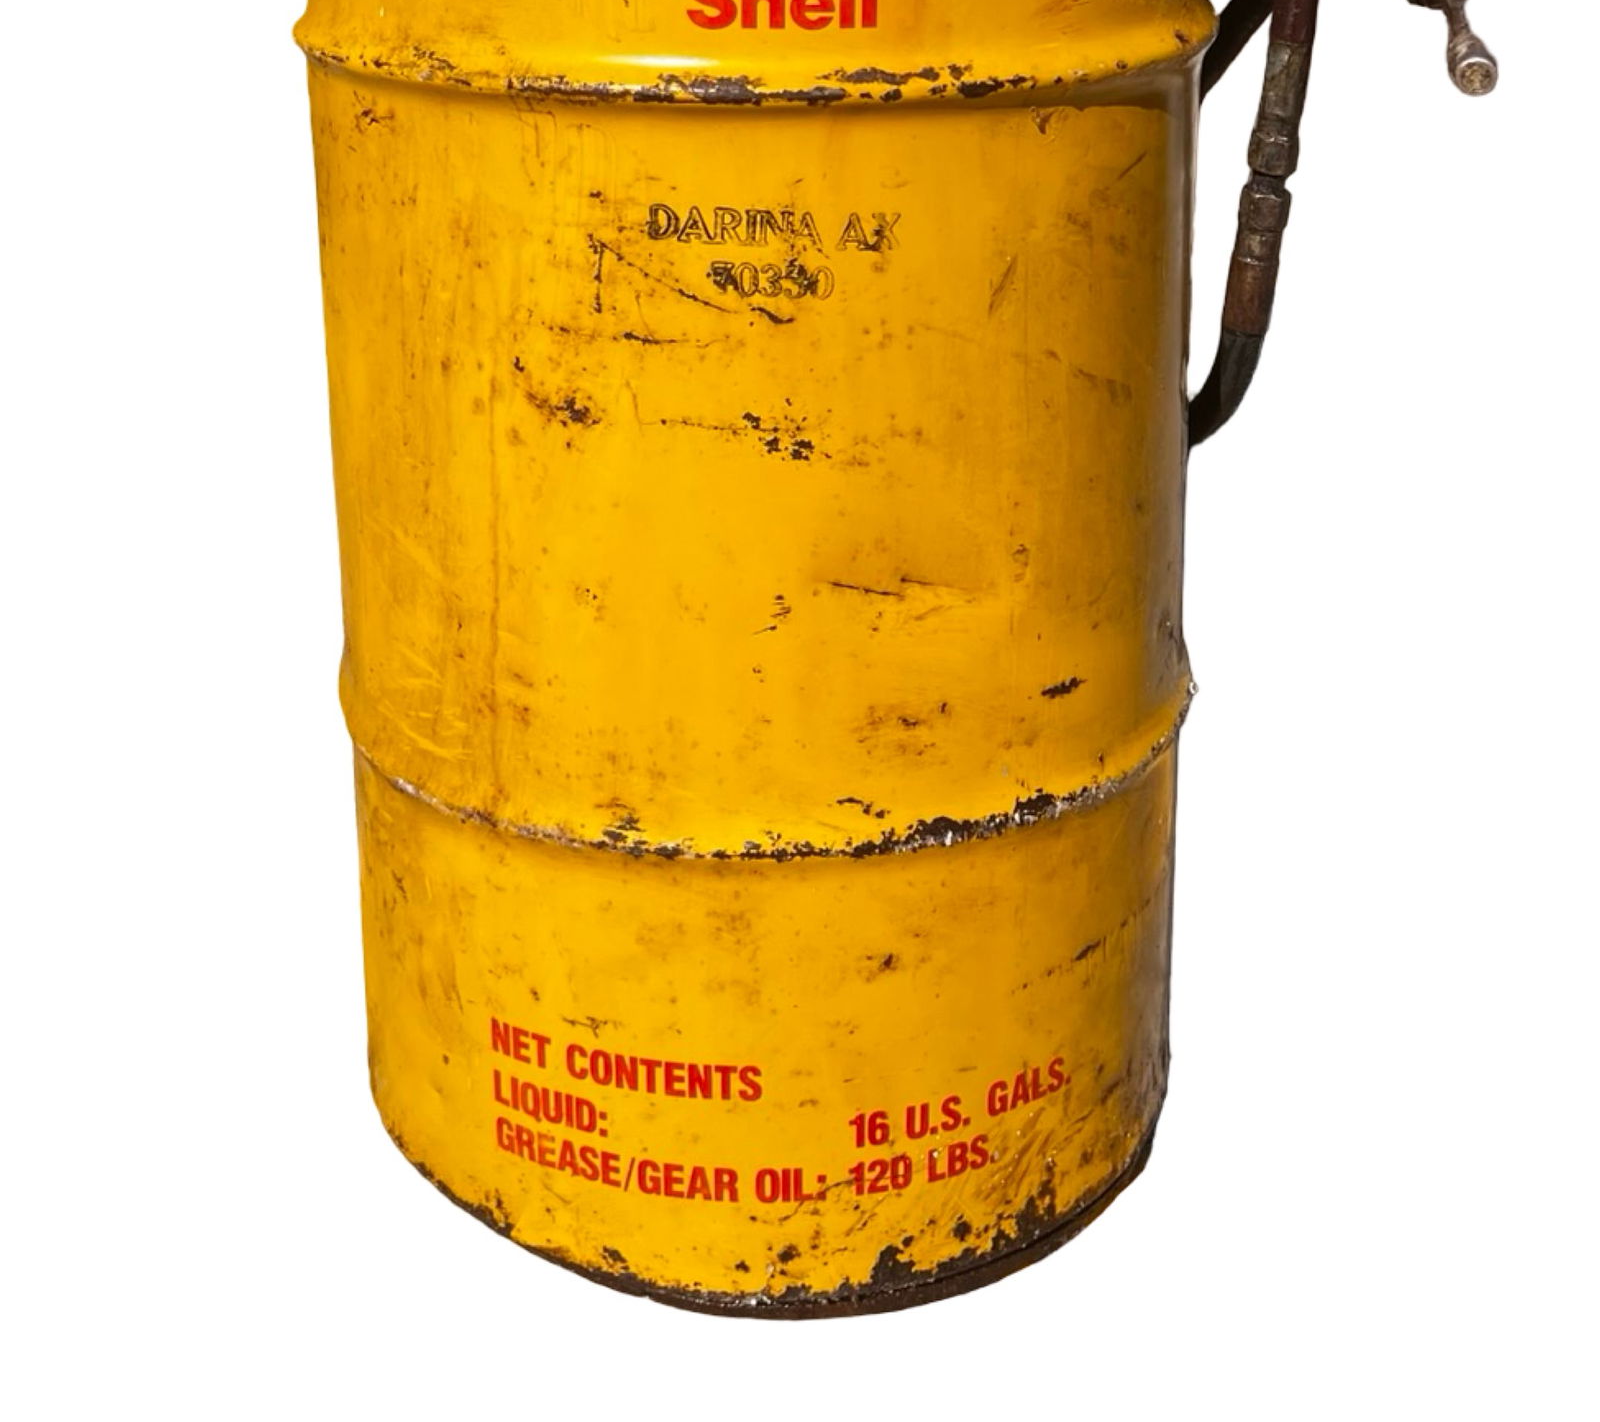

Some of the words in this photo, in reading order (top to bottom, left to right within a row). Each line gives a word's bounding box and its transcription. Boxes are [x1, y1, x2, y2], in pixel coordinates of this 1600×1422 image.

[647, 203, 822, 248] DARINA
[836, 212, 902, 251] AX
[491, 1016, 551, 1069] NET
[566, 1043, 763, 1102] CONTENTS
[493, 1069, 608, 1138] LIQUID:
[849, 1110, 890, 1148] 16
[905, 1095, 971, 1140] U.S.
[987, 1057, 1072, 1117] GALS.
[496, 1116, 739, 1203] GREASE/GEAR
[755, 1167, 827, 1203] OIL:
[848, 1153, 913, 1196] 120
[927, 1134, 995, 1183] LBS.
